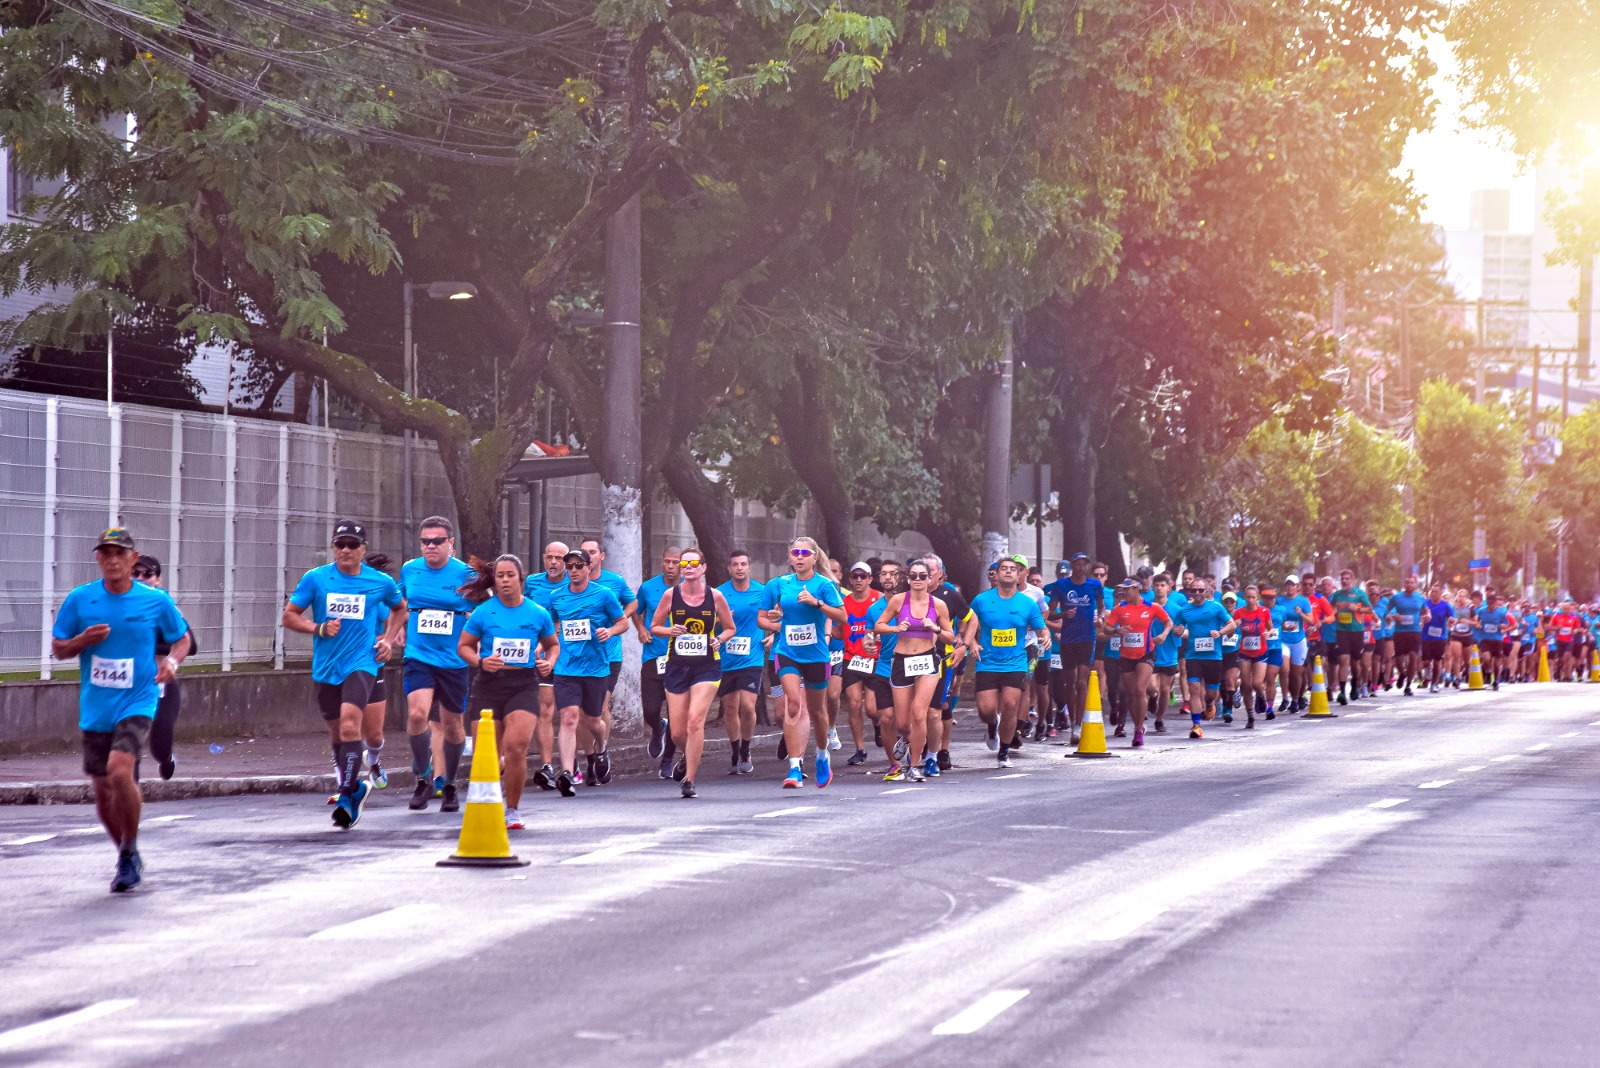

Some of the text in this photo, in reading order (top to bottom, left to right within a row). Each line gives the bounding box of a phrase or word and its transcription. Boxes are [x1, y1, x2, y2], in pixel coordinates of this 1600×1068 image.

[329, 602, 360, 614] 2035
[420, 618, 448, 630] 2184
[564, 628, 588, 637] 2124
[788, 632, 813, 642] 1062
[993, 634, 1013, 643] 7320
[677, 640, 703, 650] 6008
[727, 643, 747, 652] 2177
[495, 647, 525, 658] 1078
[907, 662, 930, 672] 1055
[92, 668, 127, 681] 2144
